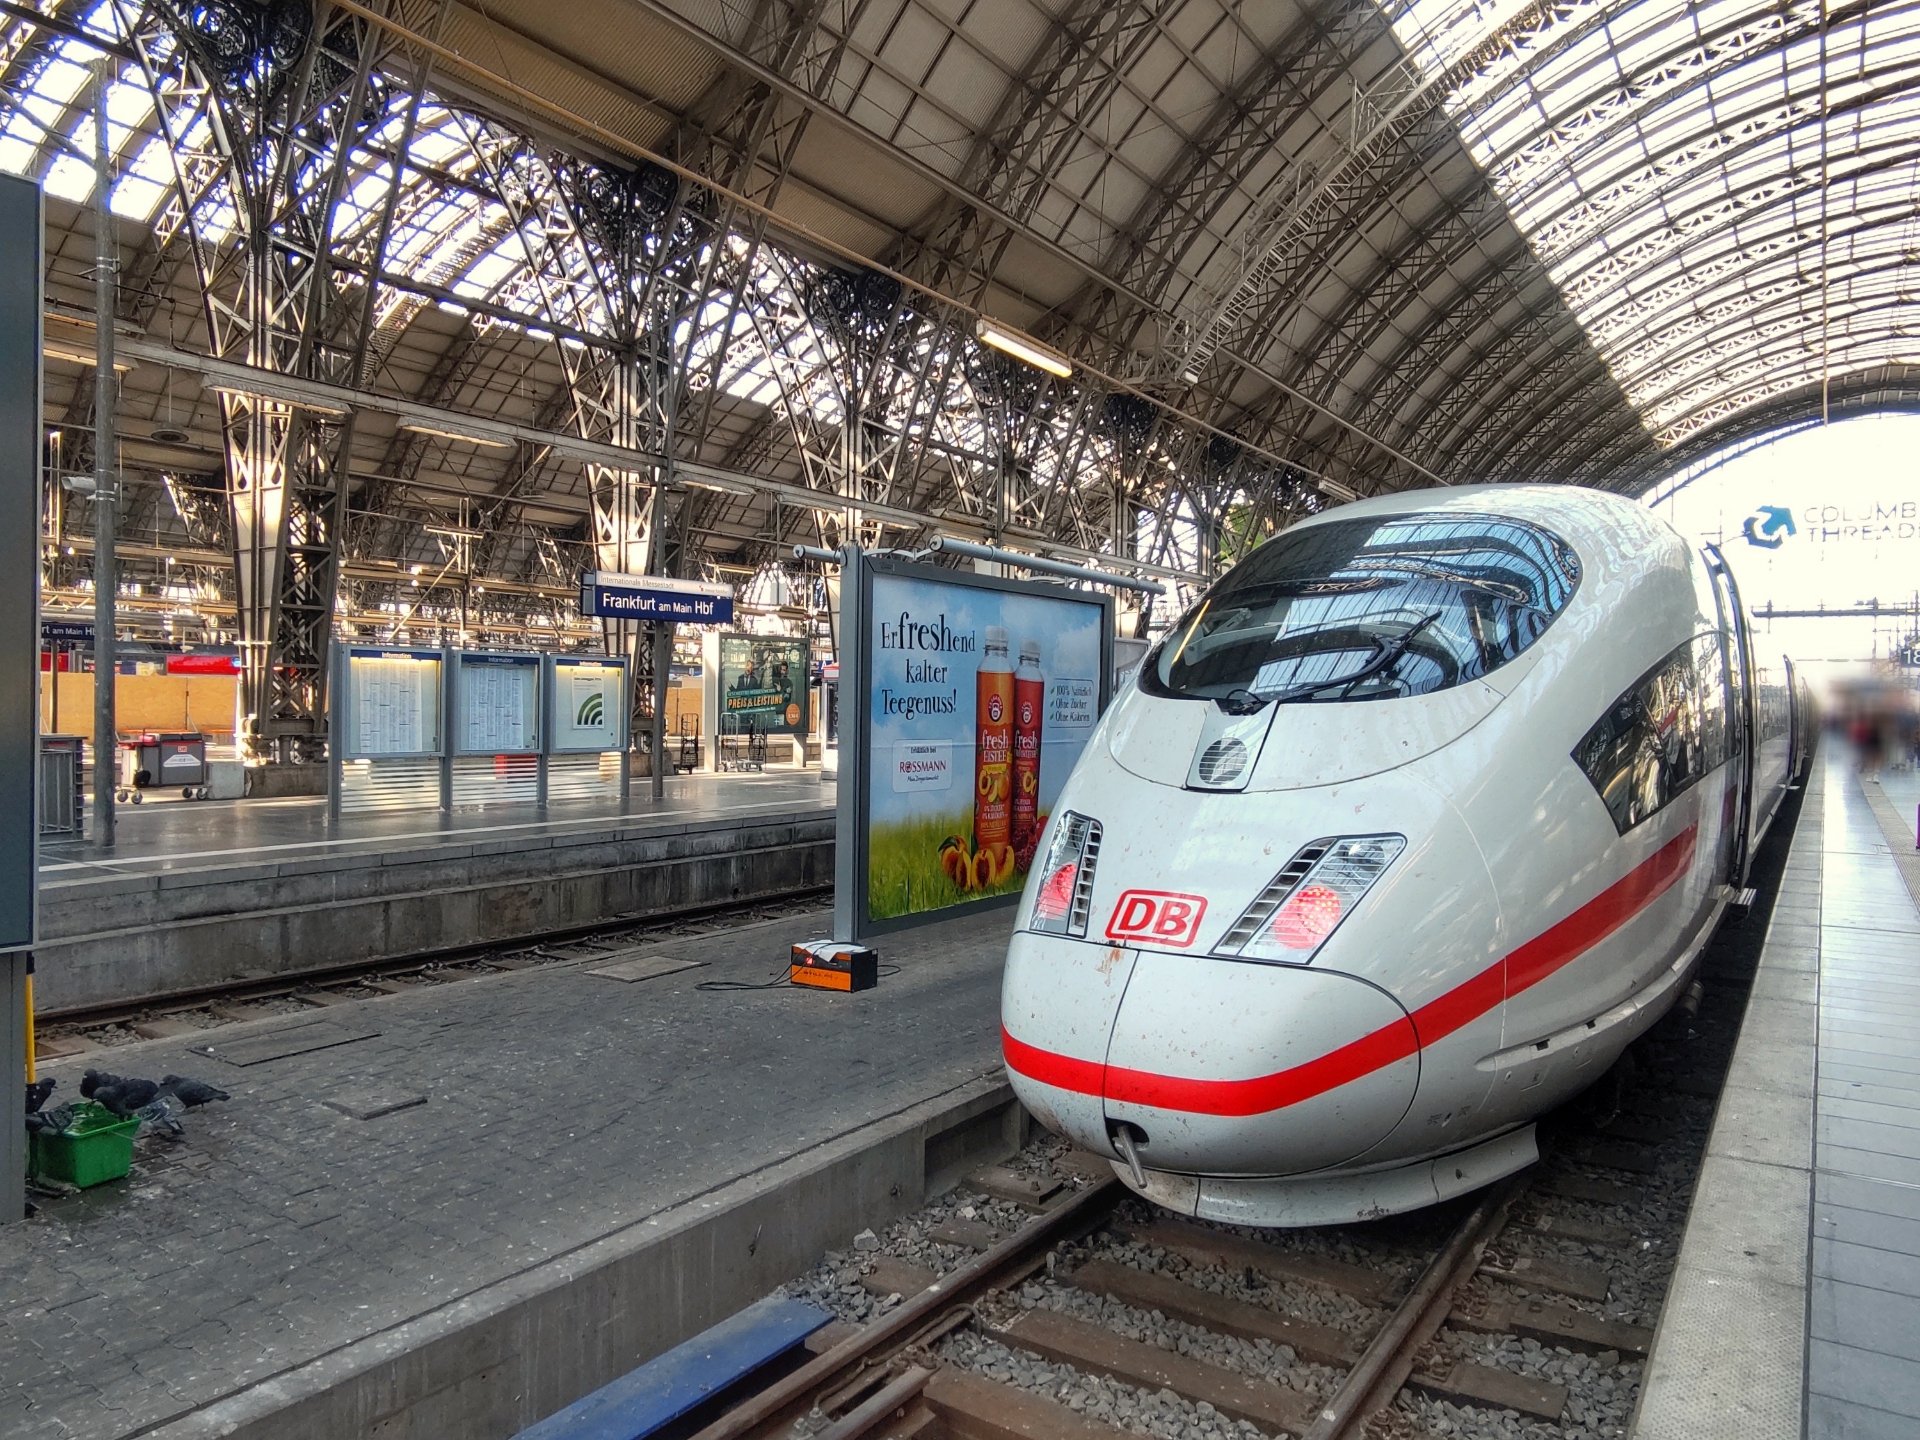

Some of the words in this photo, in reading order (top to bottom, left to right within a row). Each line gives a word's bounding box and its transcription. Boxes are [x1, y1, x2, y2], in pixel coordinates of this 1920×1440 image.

[1806, 523, 1920, 542] THREAD
[600, 575, 641, 586] Internationale
[642, 579, 674, 589] Messestadt
[603, 593, 656, 611] Frankfurt
[658, 602, 671, 612] am
[673, 602, 692, 613] Main
[695, 601, 714, 615] Hbf
[65, 627, 83, 635] Main
[881, 611, 975, 653] Erfreshend
[906, 659, 947, 683] kalter
[882, 688, 957, 720] Teegenuss!
[982, 728, 1009, 749] fresh
[1014, 729, 1038, 749] fresh
[984, 750, 1007, 762] EISTEE
[900, 760, 946, 773] ROSSMANN
[1118, 897, 1192, 936] DB
